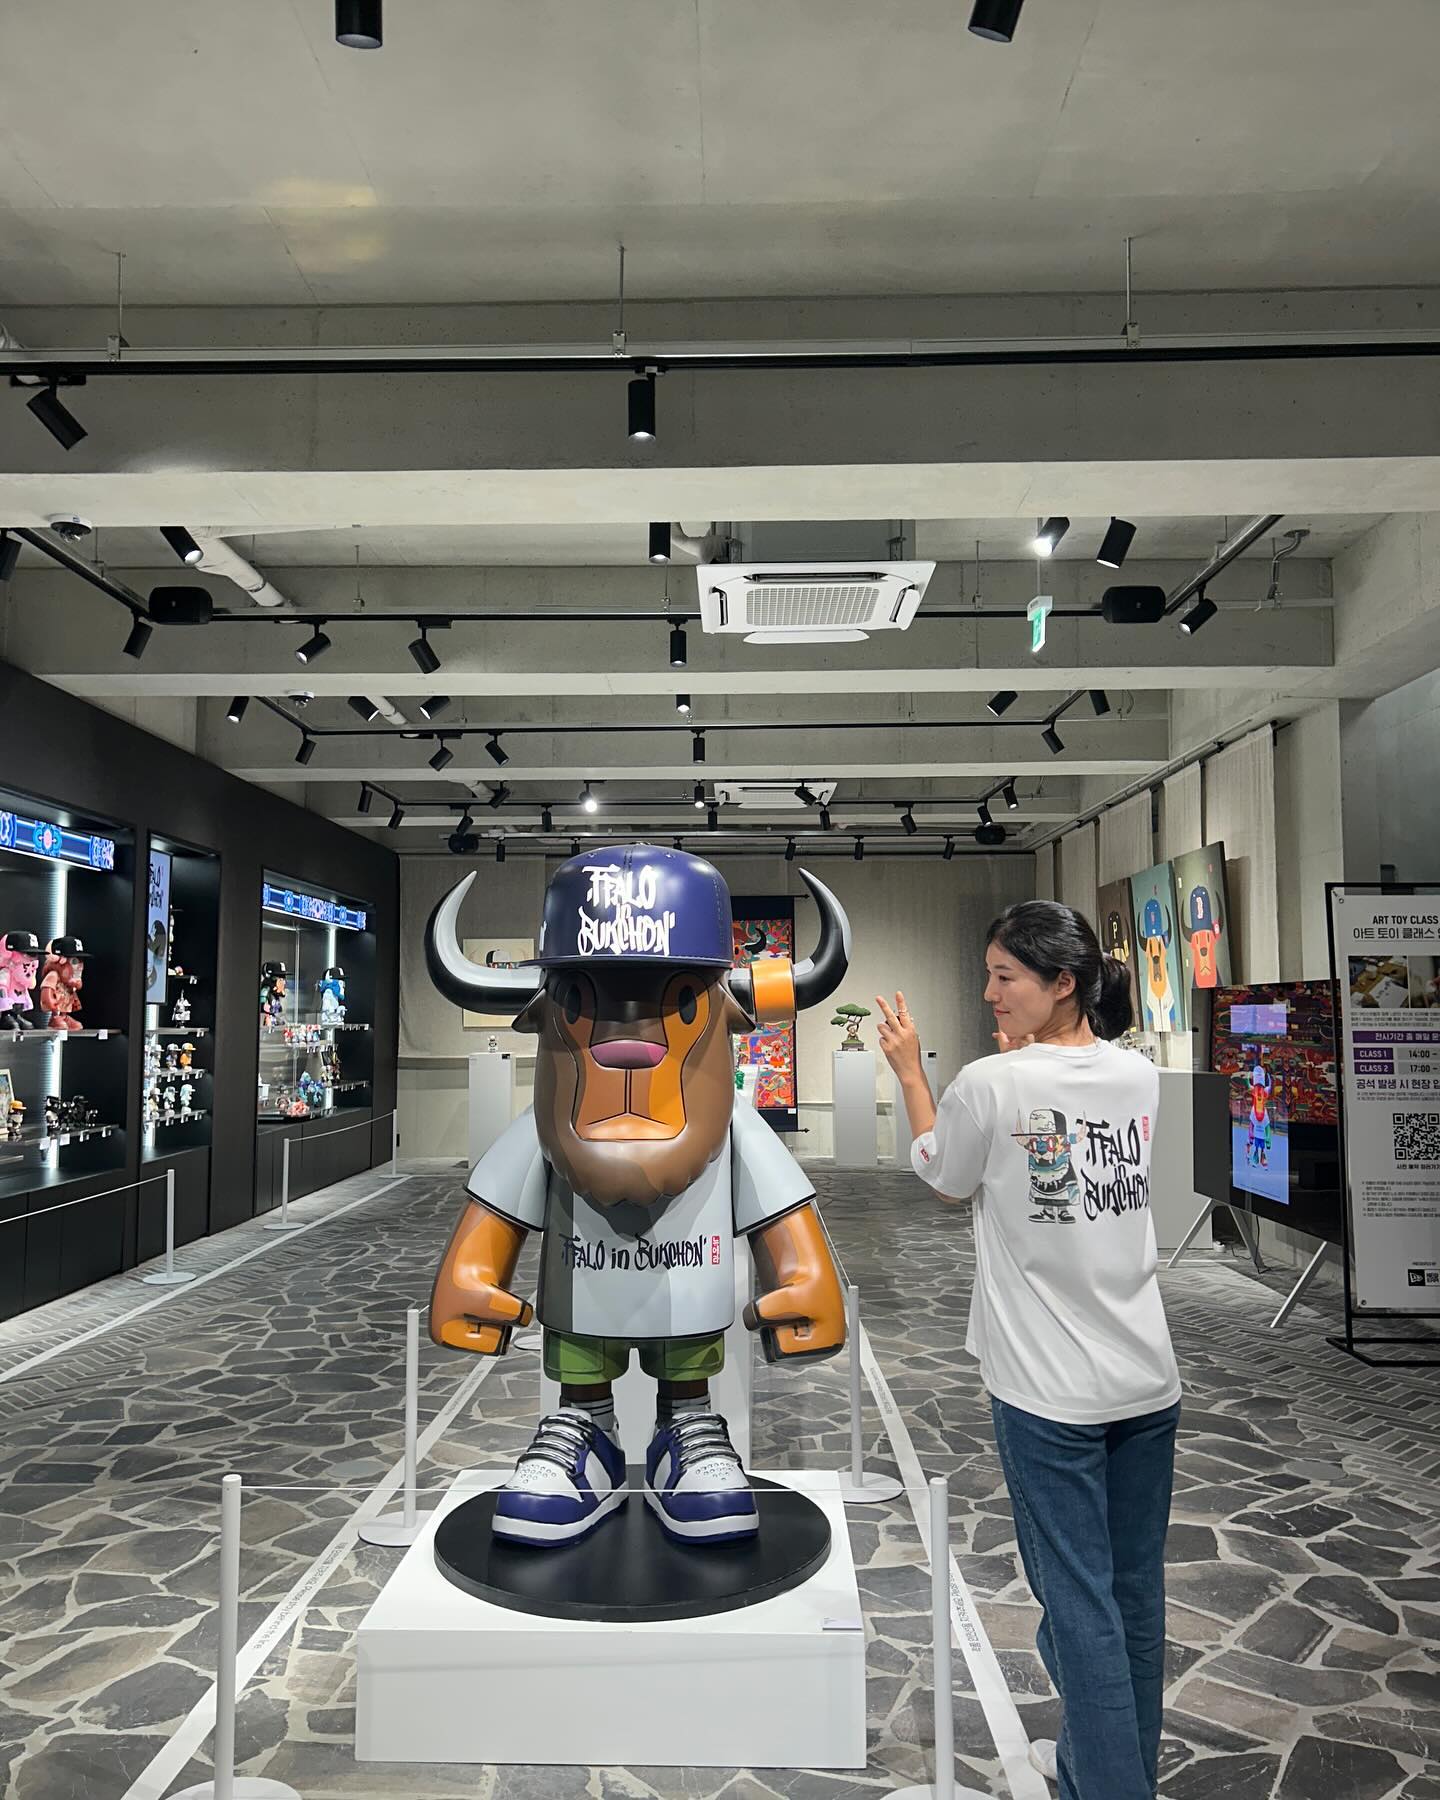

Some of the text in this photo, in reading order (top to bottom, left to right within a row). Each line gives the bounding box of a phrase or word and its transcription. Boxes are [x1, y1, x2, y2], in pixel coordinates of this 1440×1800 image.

[1372, 915, 1439, 925] ART TOY CLASS
[1353, 927, 1376, 939] 아트
[1378, 927, 1399, 939] 토이
[1403, 927, 1435, 939] 클래스
[1359, 1050, 1387, 1058] CLASS 1
[1409, 1050, 1430, 1058] 14:00
[1359, 1064, 1389, 1073] CLASS 2
[1410, 1064, 1431, 1073] 17:00
[1356, 1079, 1376, 1090] 공석
[1378, 1079, 1397, 1090] 발생
[1399, 1079, 1409, 1090] 시
[1411, 1079, 1431, 1090] 현장
[611, 1248, 630, 1270] in
